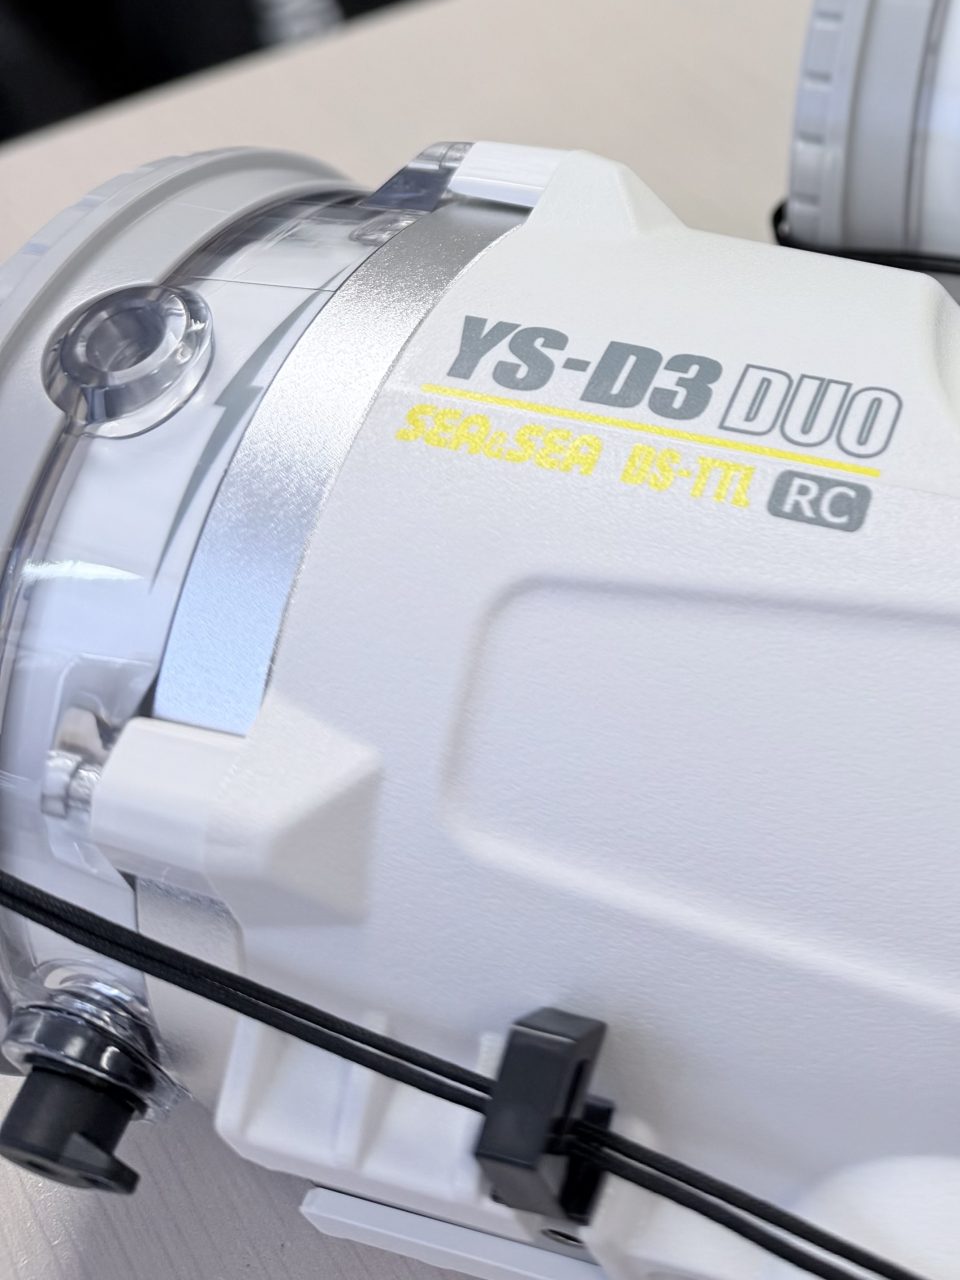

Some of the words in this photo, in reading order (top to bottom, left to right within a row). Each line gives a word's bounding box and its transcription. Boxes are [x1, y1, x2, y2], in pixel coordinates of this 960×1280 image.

[447, 314, 723, 422] YS-D3
[718, 363, 904, 459] DUO
[395, 403, 604, 476] SEA&SEA
[619, 443, 758, 509] DS-TTL
[781, 481, 857, 526] RC
